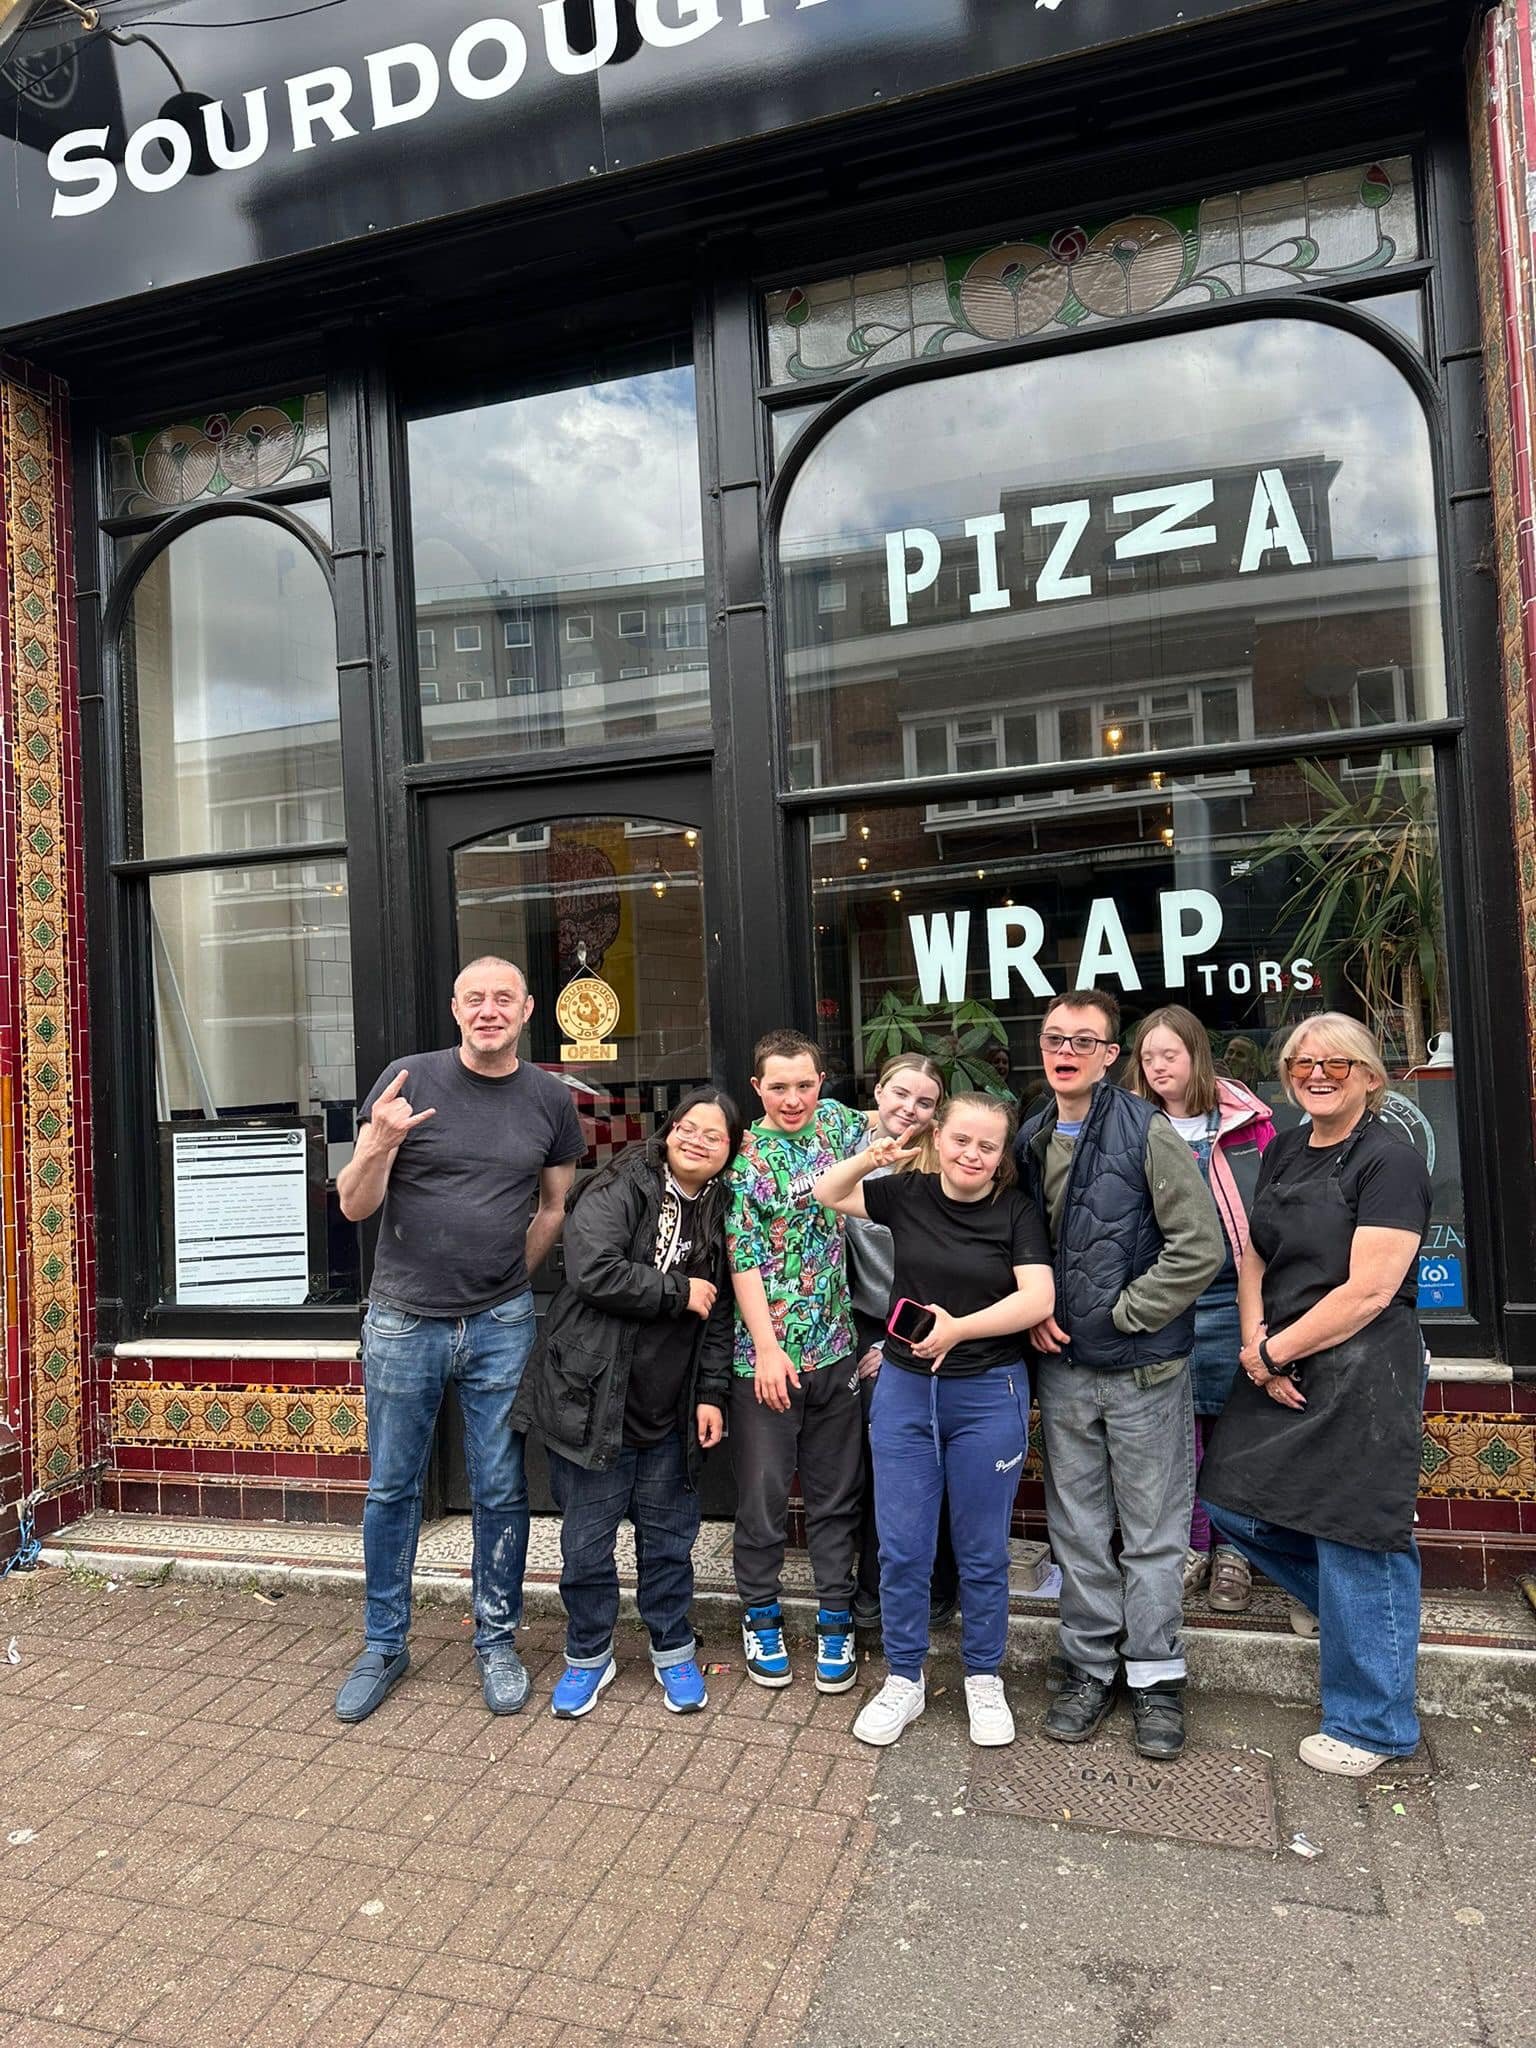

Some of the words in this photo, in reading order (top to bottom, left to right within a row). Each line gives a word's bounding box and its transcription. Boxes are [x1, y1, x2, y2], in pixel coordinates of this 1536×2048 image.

[885, 468, 1311, 627] PIZZA
[559, 983, 615, 1011] SOURDOUGH
[577, 1029, 600, 1038] JOE
[567, 1045, 611, 1059] OPEN
[1081, 1768, 1162, 1791] CATV
